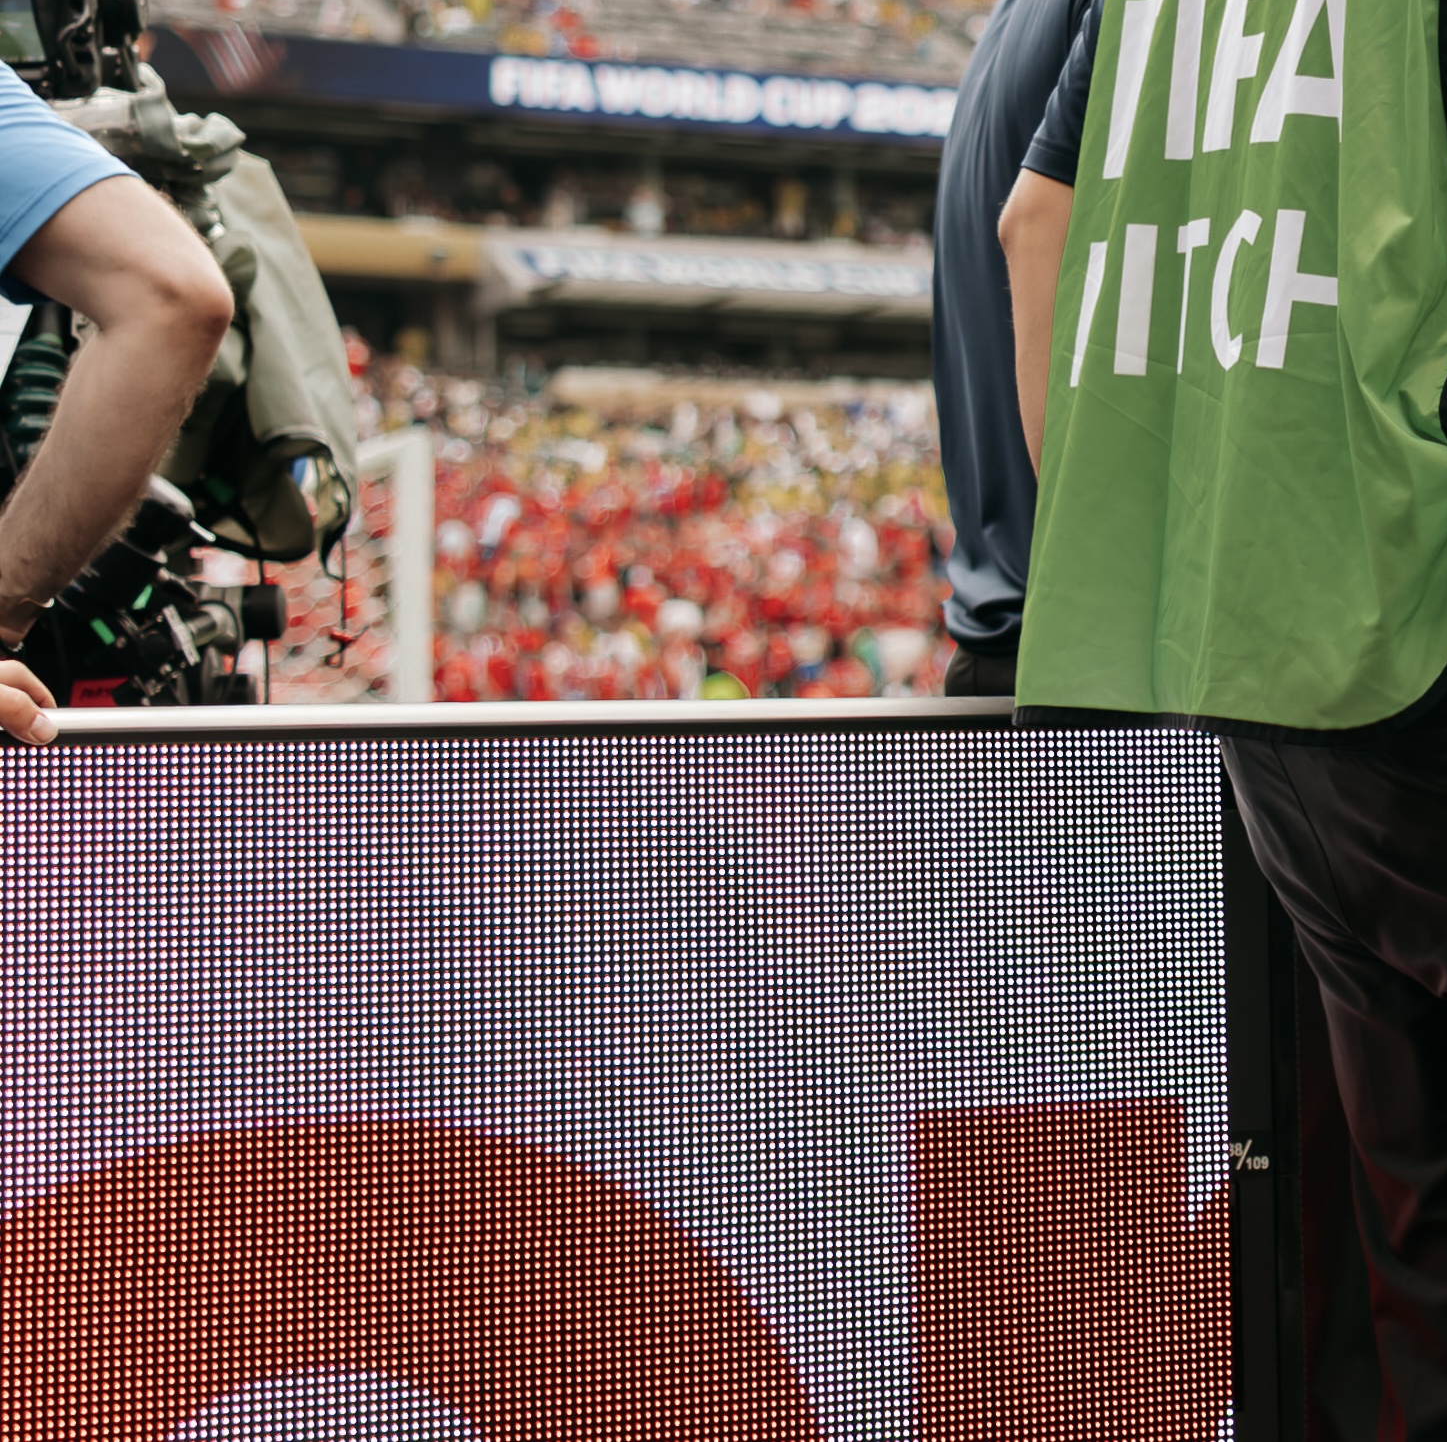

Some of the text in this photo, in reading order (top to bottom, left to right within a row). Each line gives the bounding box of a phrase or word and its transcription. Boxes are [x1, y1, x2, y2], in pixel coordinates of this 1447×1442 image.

[490, 57, 596, 112] FIFA
[596, 63, 761, 123] WORLD
[761, 76, 853, 129] CUP
